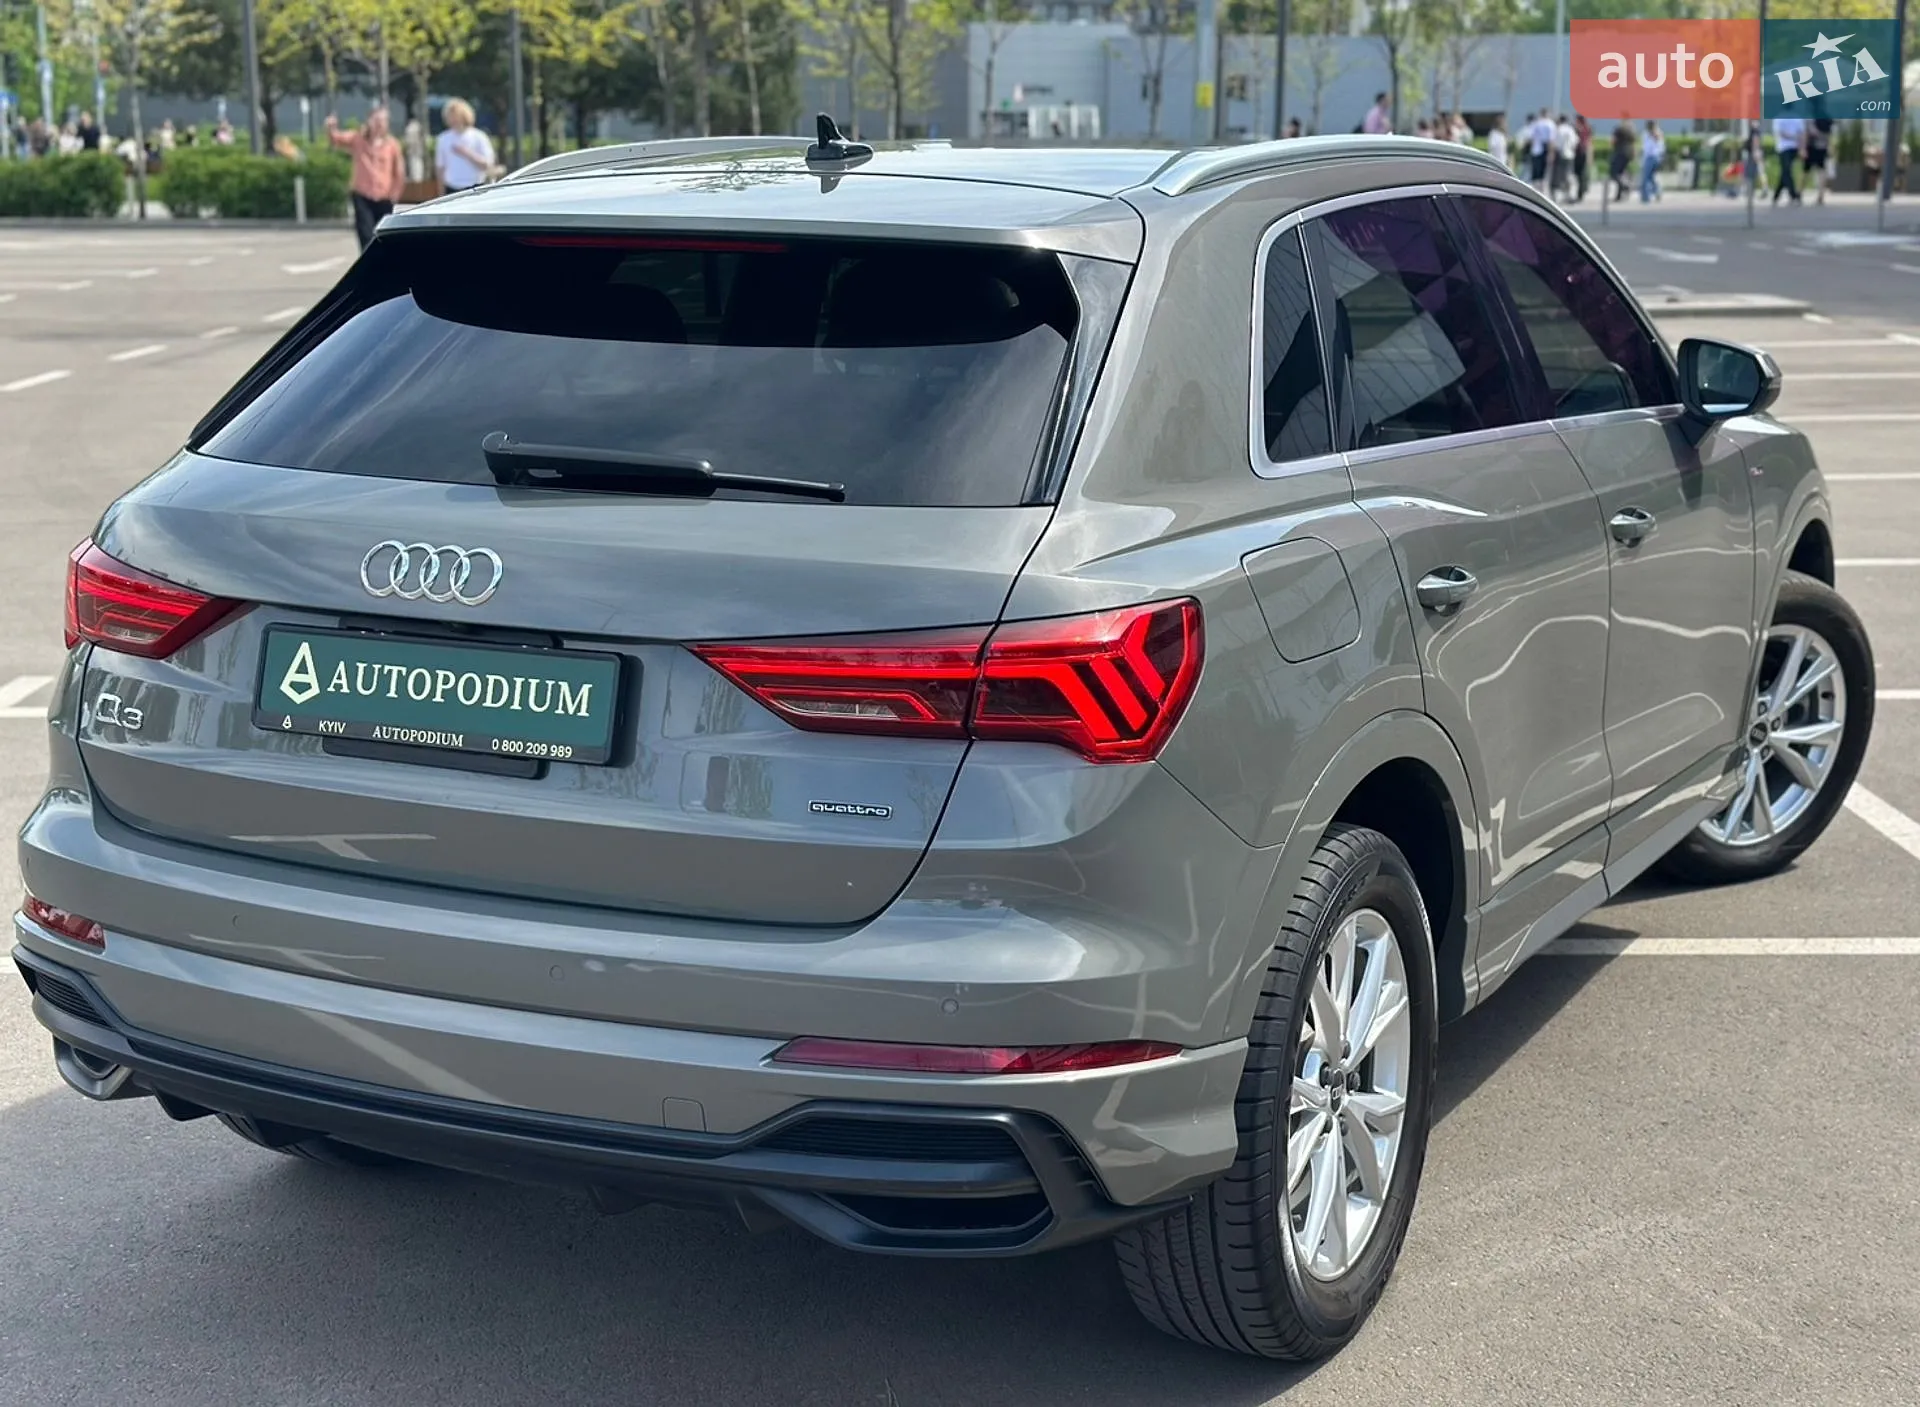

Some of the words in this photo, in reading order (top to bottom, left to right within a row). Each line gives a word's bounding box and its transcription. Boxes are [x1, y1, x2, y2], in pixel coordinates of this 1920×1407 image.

[327, 660, 593, 717] AUTOPODIUM
[96, 692, 143, 730] Q3
[318, 719, 347, 734] KYIV
[372, 725, 464, 747] AUTOPODIUM
[492, 739, 500, 751] 0
[501, 740, 524, 753] 800
[526, 742, 548, 756] 209
[549, 744, 572, 758] 989
[812, 803, 888, 816] quattro
